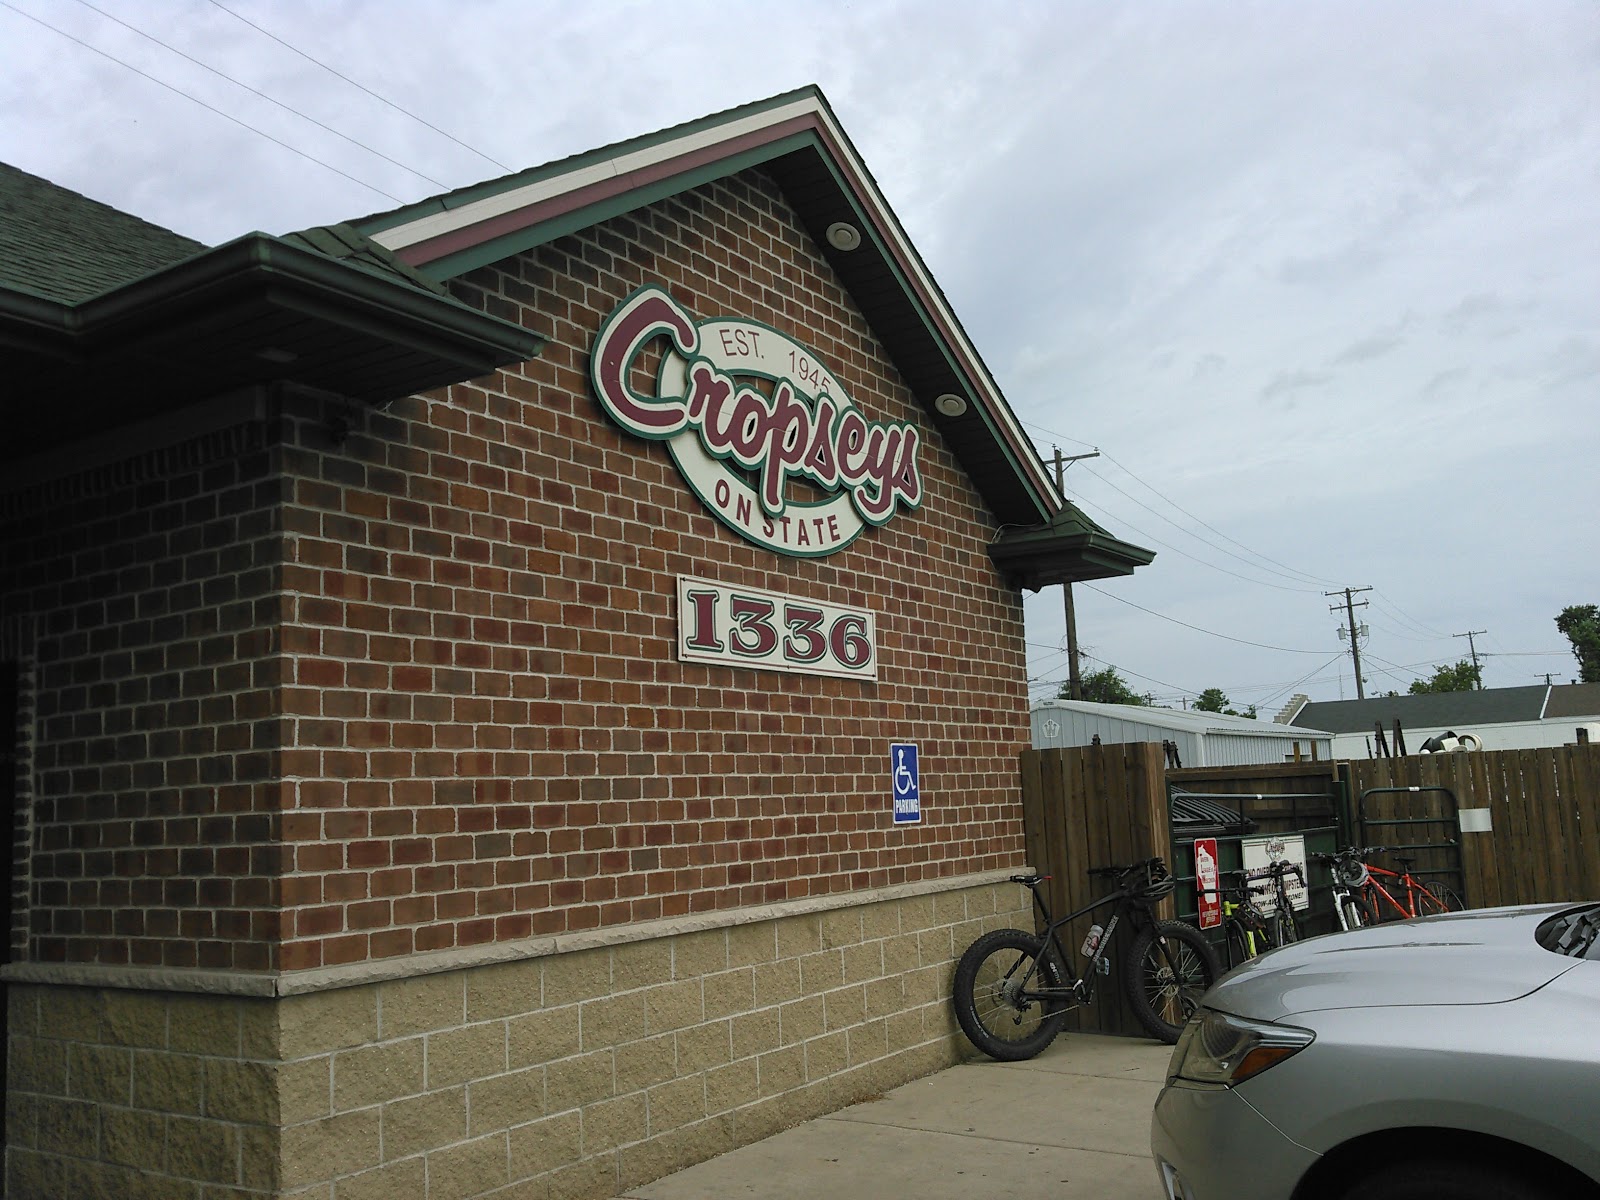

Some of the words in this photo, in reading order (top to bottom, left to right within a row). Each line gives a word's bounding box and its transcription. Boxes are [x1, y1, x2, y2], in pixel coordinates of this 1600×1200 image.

[719, 328, 765, 360] EST.
[788, 350, 831, 394] 1945
[598, 295, 919, 516] Cropseys
[715, 478, 752, 527] ON
[762, 514, 841, 547] STATE
[686, 589, 872, 669] 1336
[895, 798, 918, 814] PARKING
